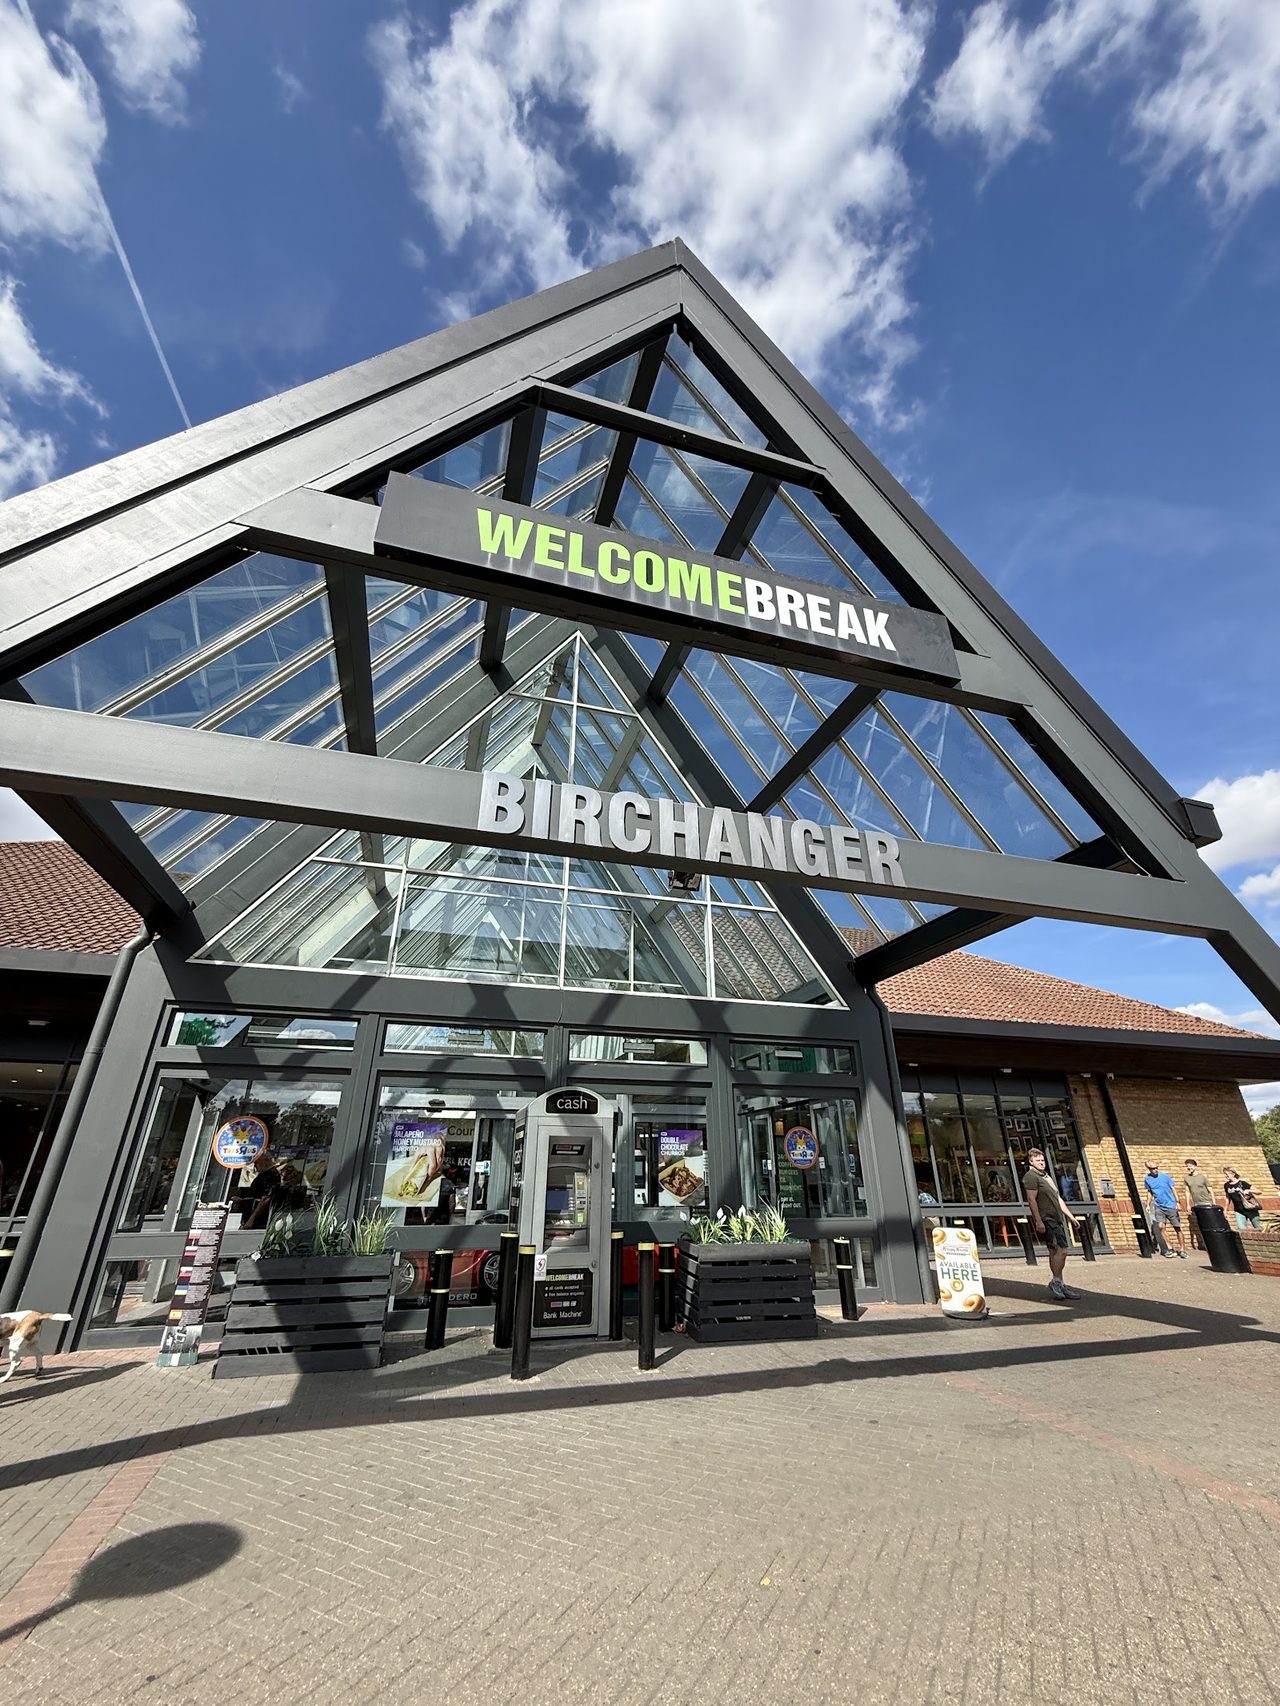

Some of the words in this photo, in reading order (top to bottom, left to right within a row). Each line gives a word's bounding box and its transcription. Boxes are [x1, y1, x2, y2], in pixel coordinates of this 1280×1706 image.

[476, 507, 897, 653] WELCOMEBREAK
[477, 771, 906, 888] BIRCHANGER
[556, 1096, 588, 1110] cash
[394, 1130, 424, 1138] JALAPEÑO
[448, 1125, 475, 1136] Cour
[393, 1138, 413, 1146] HONEY
[413, 1138, 442, 1146] MUSTARD
[660, 1136, 680, 1144] DOUBLE
[660, 1143, 689, 1151] CHOCOLATE
[940, 1261, 977, 1269] AVAILABLE
[941, 1268, 979, 1281] HERE
[448, 1293, 477, 1301] DERO
[543, 1311, 558, 1319] Bank
